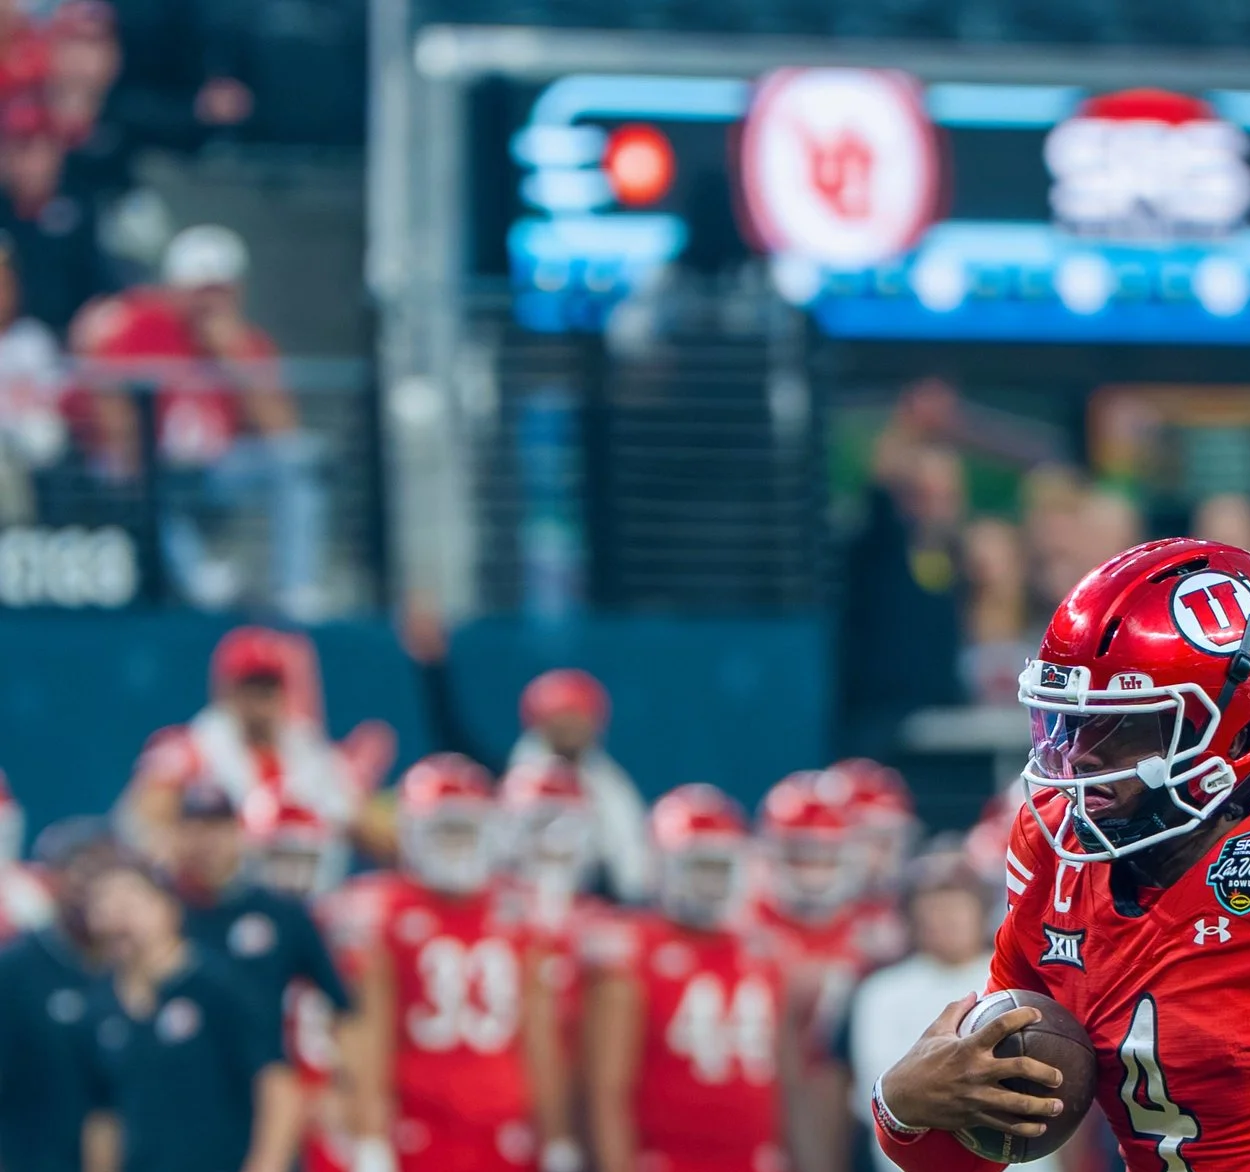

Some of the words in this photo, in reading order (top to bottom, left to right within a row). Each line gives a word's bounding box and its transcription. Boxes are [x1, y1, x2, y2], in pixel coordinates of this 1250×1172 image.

[1179, 579, 1239, 648] U
[1053, 859, 1084, 913] C
[1210, 857, 1238, 880] Las
[1041, 928, 1083, 967] XII
[405, 935, 525, 1053] 33
[663, 973, 778, 1085] 44
